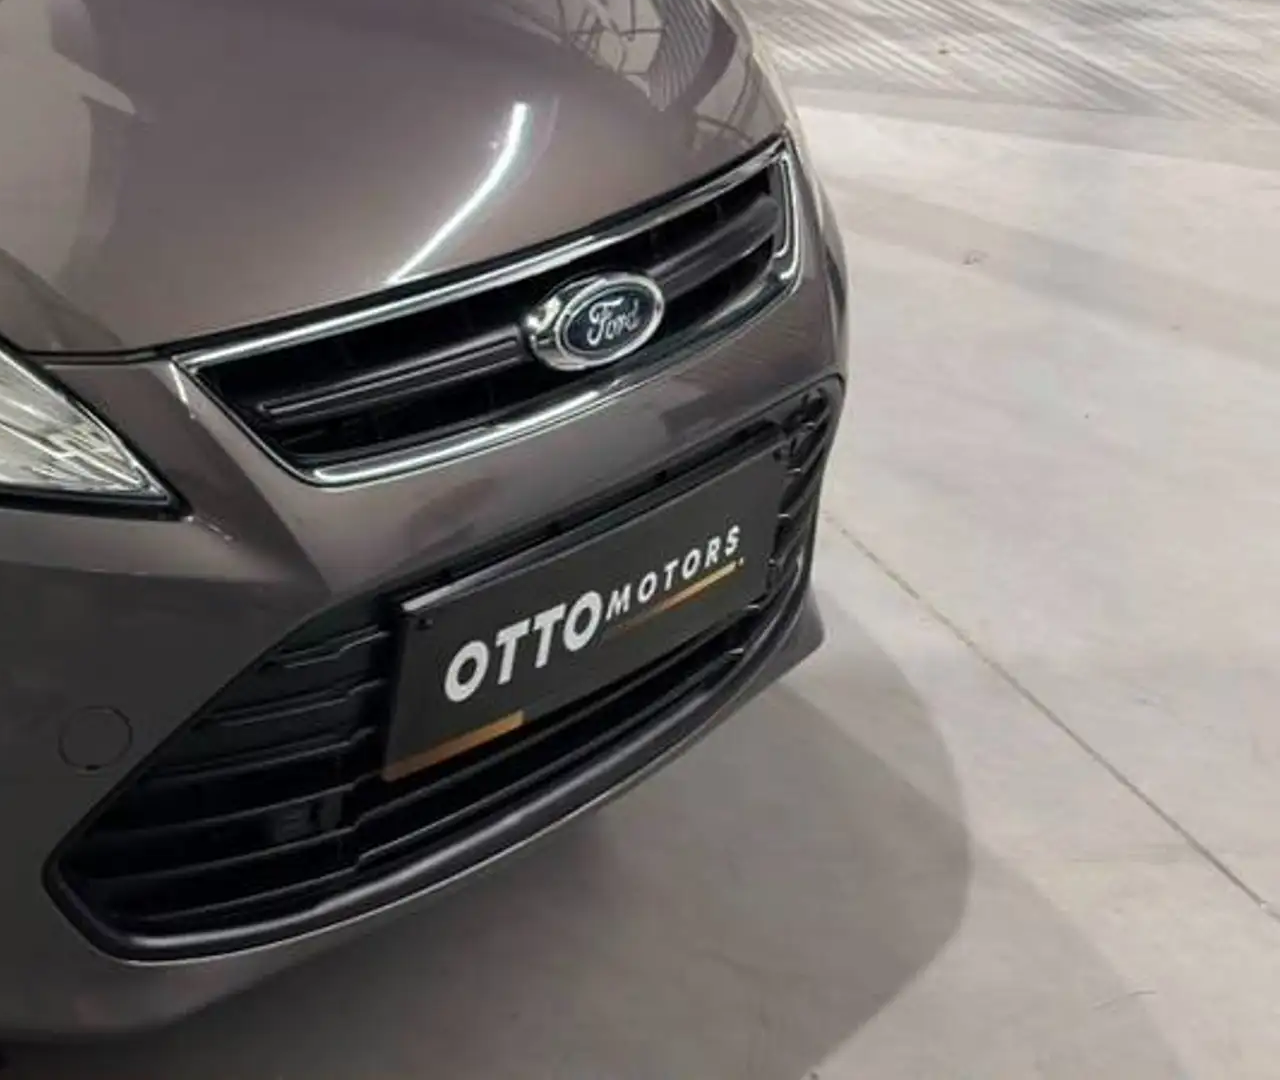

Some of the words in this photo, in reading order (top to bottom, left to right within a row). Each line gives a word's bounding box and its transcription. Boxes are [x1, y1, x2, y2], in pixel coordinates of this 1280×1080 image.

[587, 297, 639, 346] Ford
[444, 590, 603, 703] OTTO
[606, 525, 740, 621] MOTORS
